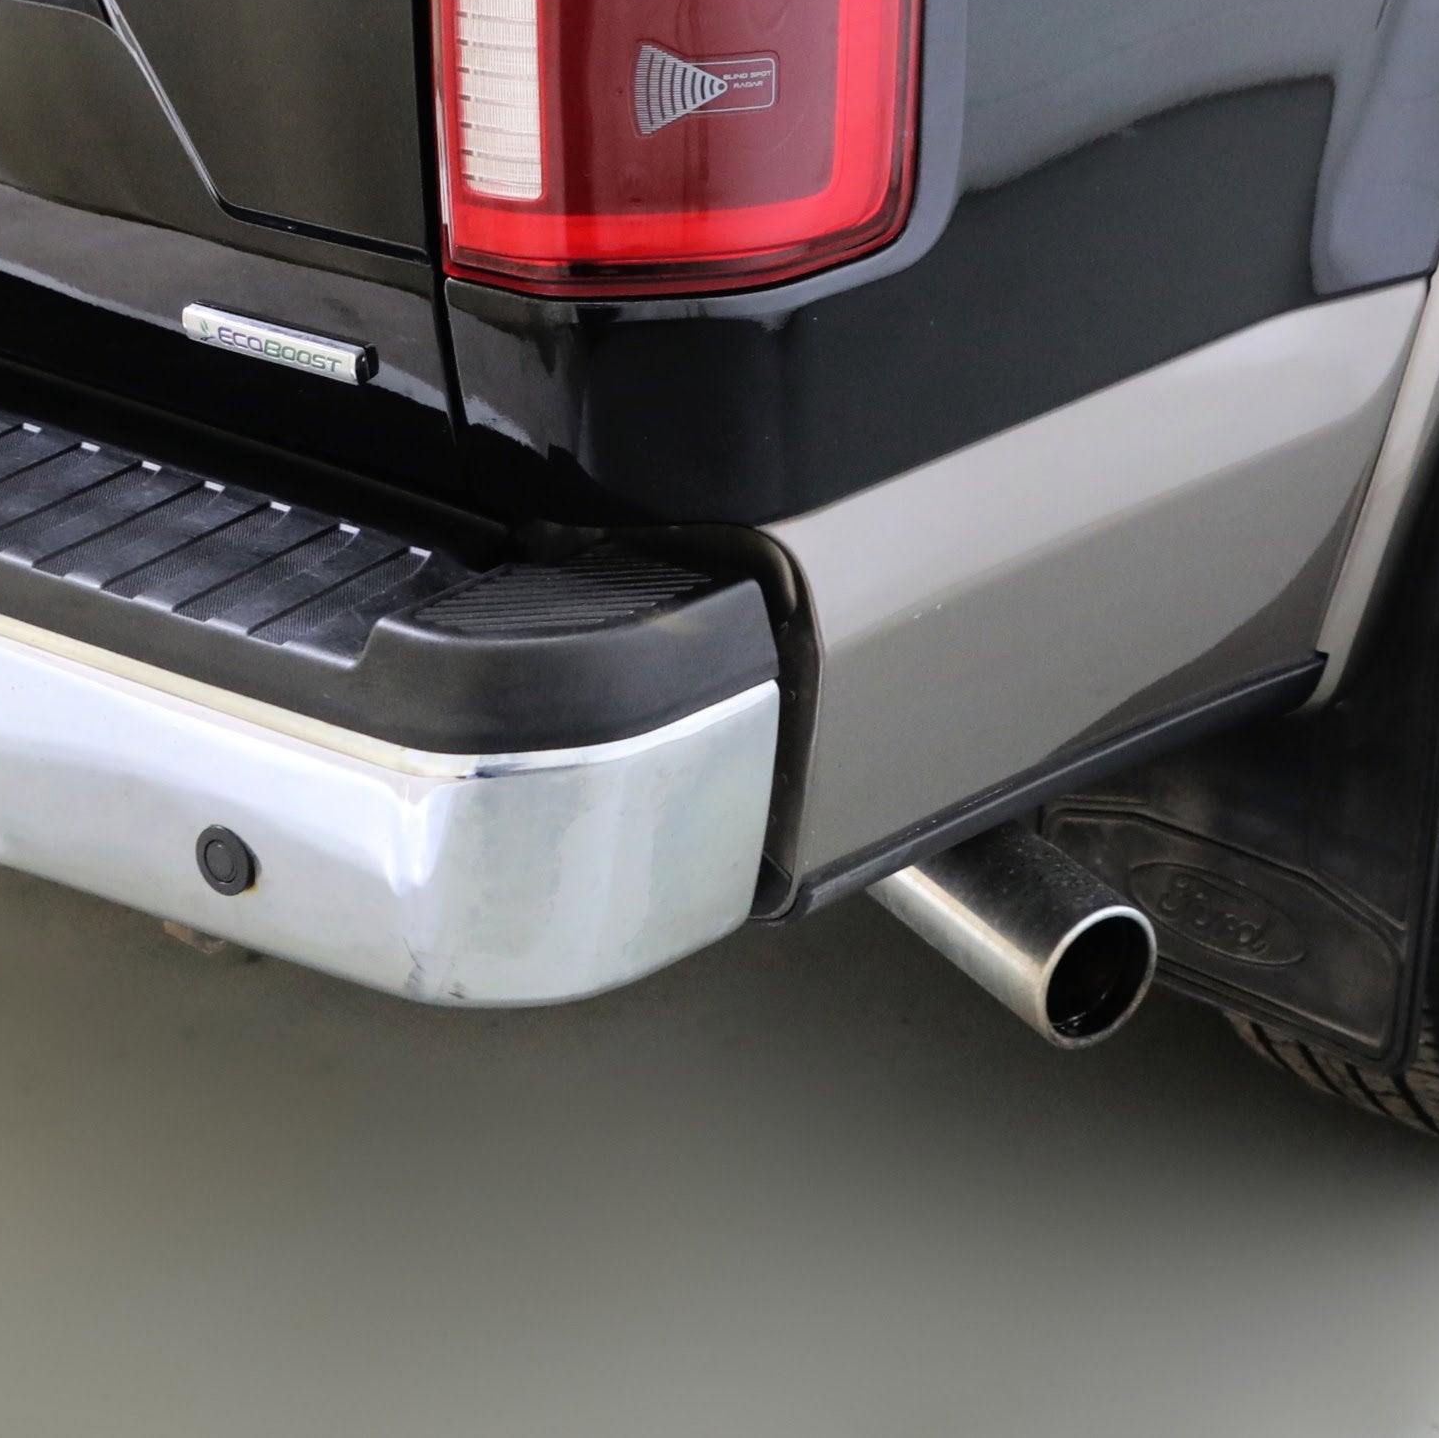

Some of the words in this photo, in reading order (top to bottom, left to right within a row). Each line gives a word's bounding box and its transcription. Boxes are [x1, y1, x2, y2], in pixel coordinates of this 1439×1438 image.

[723, 72, 748, 80] BLIND
[750, 70, 772, 78] SPOT
[733, 80, 763, 89] RADAR
